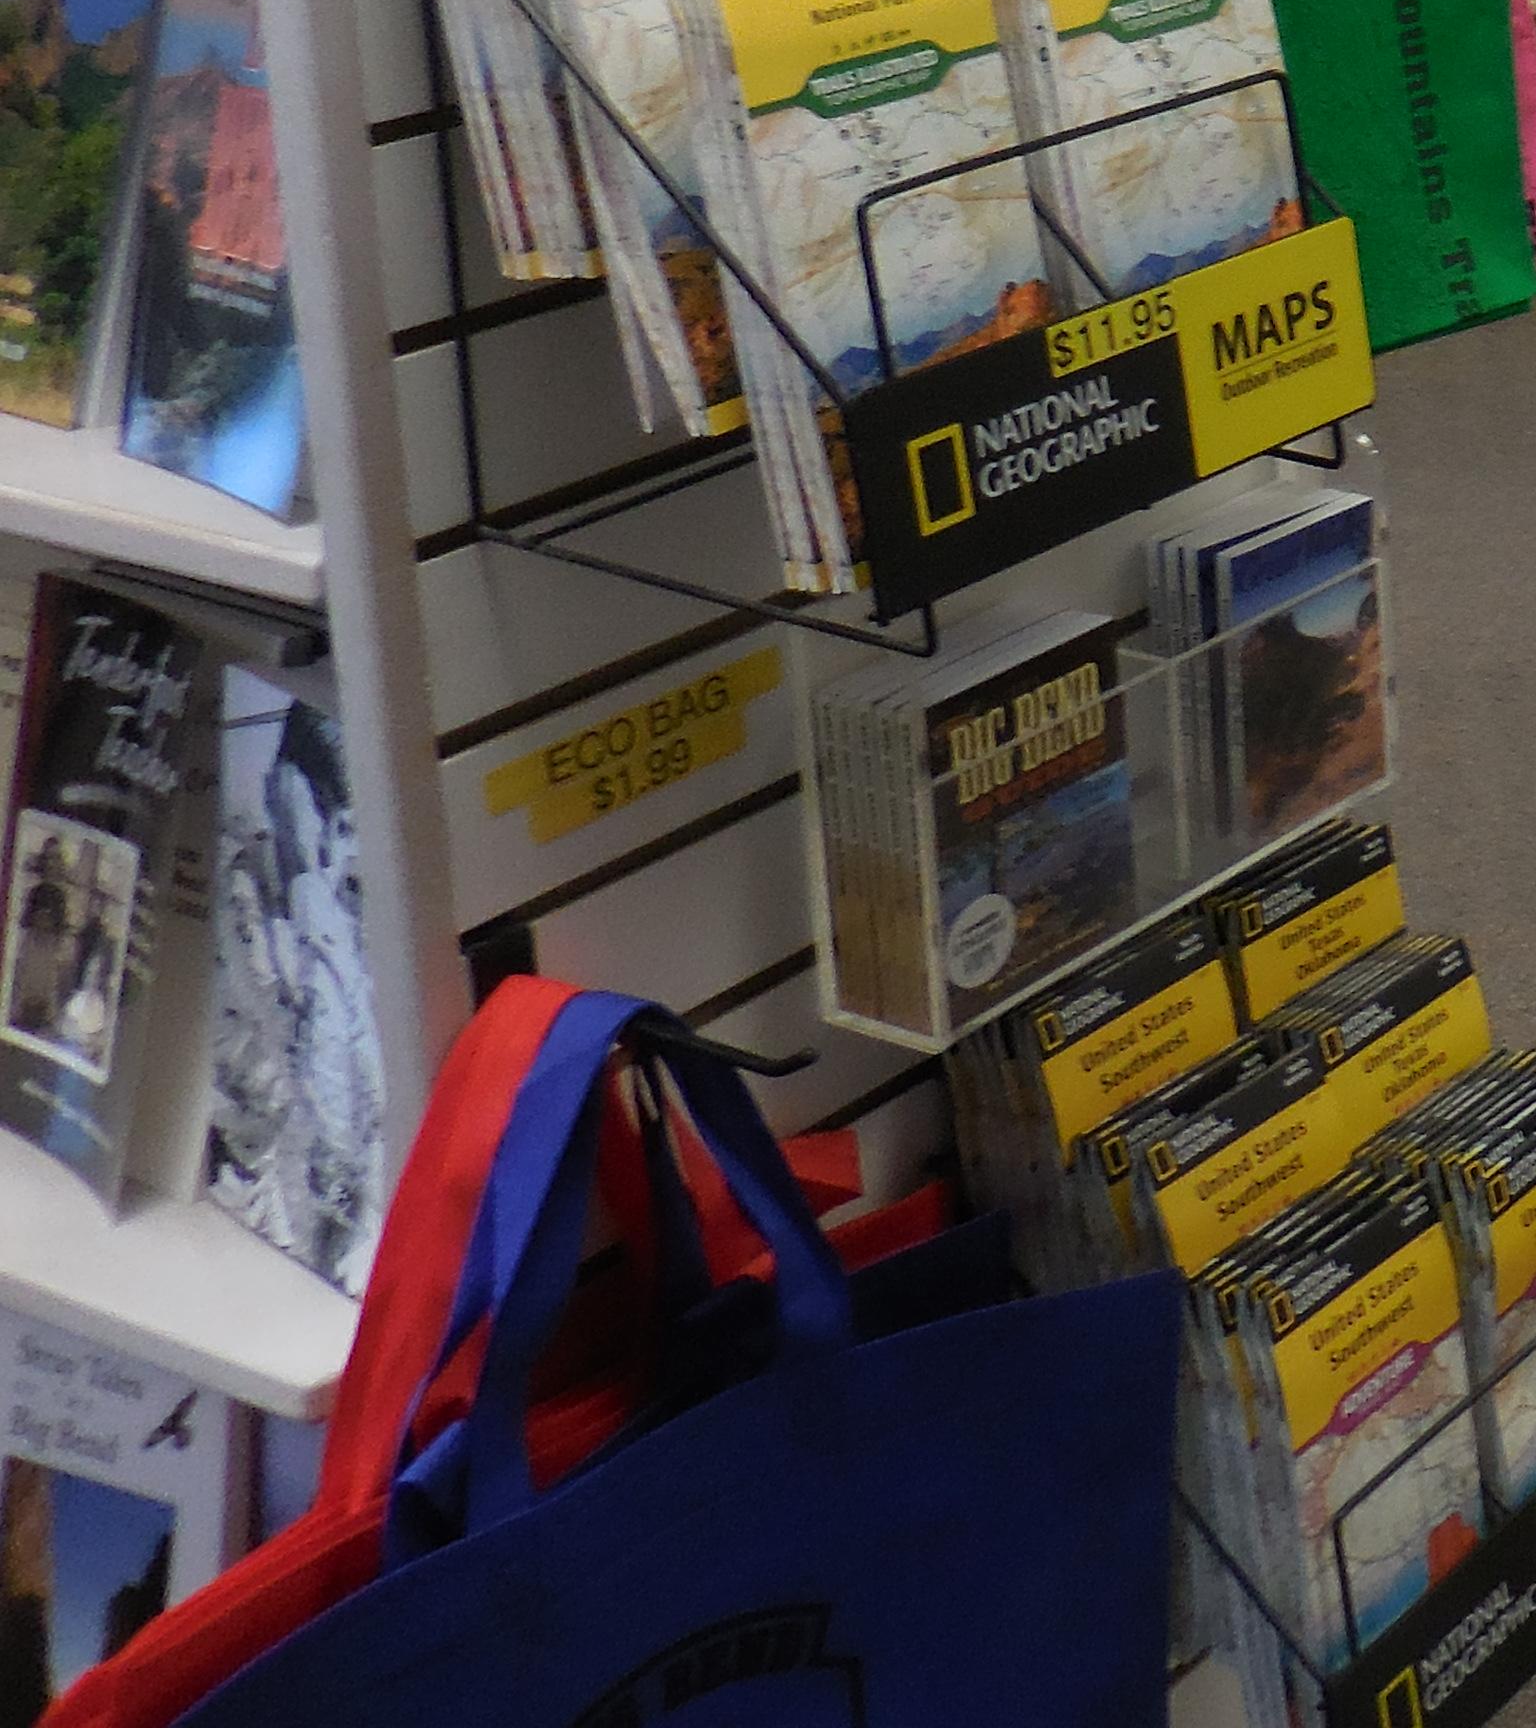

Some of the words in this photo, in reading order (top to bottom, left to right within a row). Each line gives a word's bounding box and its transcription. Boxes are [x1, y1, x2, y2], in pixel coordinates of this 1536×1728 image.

[1051, 289, 1178, 369] $11.95
[1211, 279, 1335, 372] MAPS
[1221, 370, 1273, 402] Outdoor
[1274, 341, 1339, 382] Recreation
[972, 376, 1120, 458] NATIONAL
[979, 397, 1160, 499] GEOGRAPHIC
[543, 717, 638, 785] ECO
[648, 674, 730, 738] BAG
[591, 737, 690, 811] $1.99
[1278, 915, 1328, 951] United
[1324, 892, 1367, 925] States
[1308, 923, 1345, 952] Texas
[1079, 1032, 1138, 1075] United
[1141, 994, 1194, 1037] States
[1100, 1029, 1192, 1094] Southwest
[1363, 1032, 1412, 1075] United
[1412, 1008, 1450, 1043] States
[1198, 1158, 1256, 1201] United
[1257, 1122, 1308, 1163] States
[1216, 1157, 1305, 1223] Southwest
[1307, 1298, 1367, 1354] United
[1368, 1261, 1422, 1307] States
[1329, 1300, 1417, 1372] Southwest
[1419, 1580, 1514, 1675] NATIONAL
